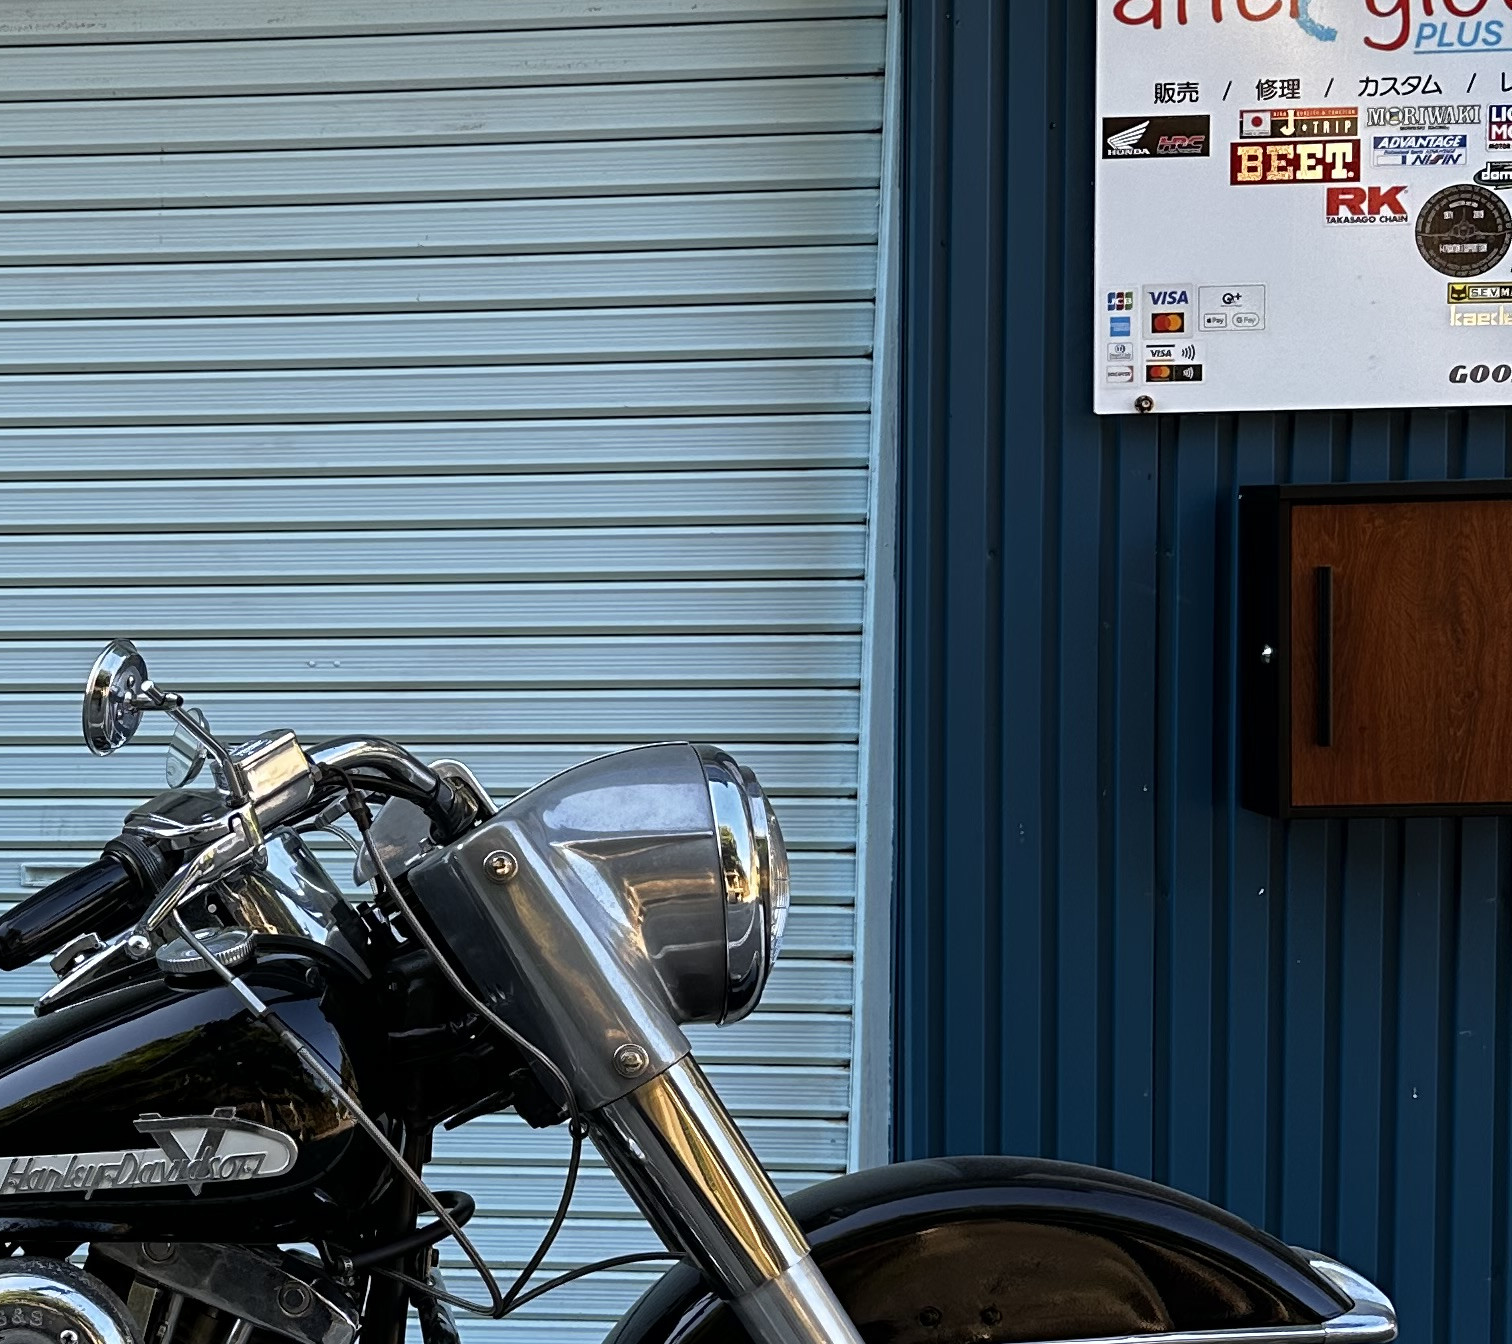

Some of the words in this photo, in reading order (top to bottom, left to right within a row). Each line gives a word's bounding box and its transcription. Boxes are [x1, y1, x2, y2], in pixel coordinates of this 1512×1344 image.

[1415, 20, 1504, 48] PLUS
[1154, 82, 1200, 104] 販売
[1255, 78, 1302, 100] 修理
[1358, 76, 1443, 97] カスタム
[1366, 105, 1481, 126] MORIWAKI
[1157, 136, 1205, 154] HRC
[1377, 136, 1462, 148] ADVANTAGE
[1326, 186, 1408, 216] RK
[1326, 215, 1376, 224] TAKASAGO
[1379, 214, 1408, 223] CHAIN
[1149, 291, 1188, 305] VISA
[1150, 349, 1172, 358] VISA
